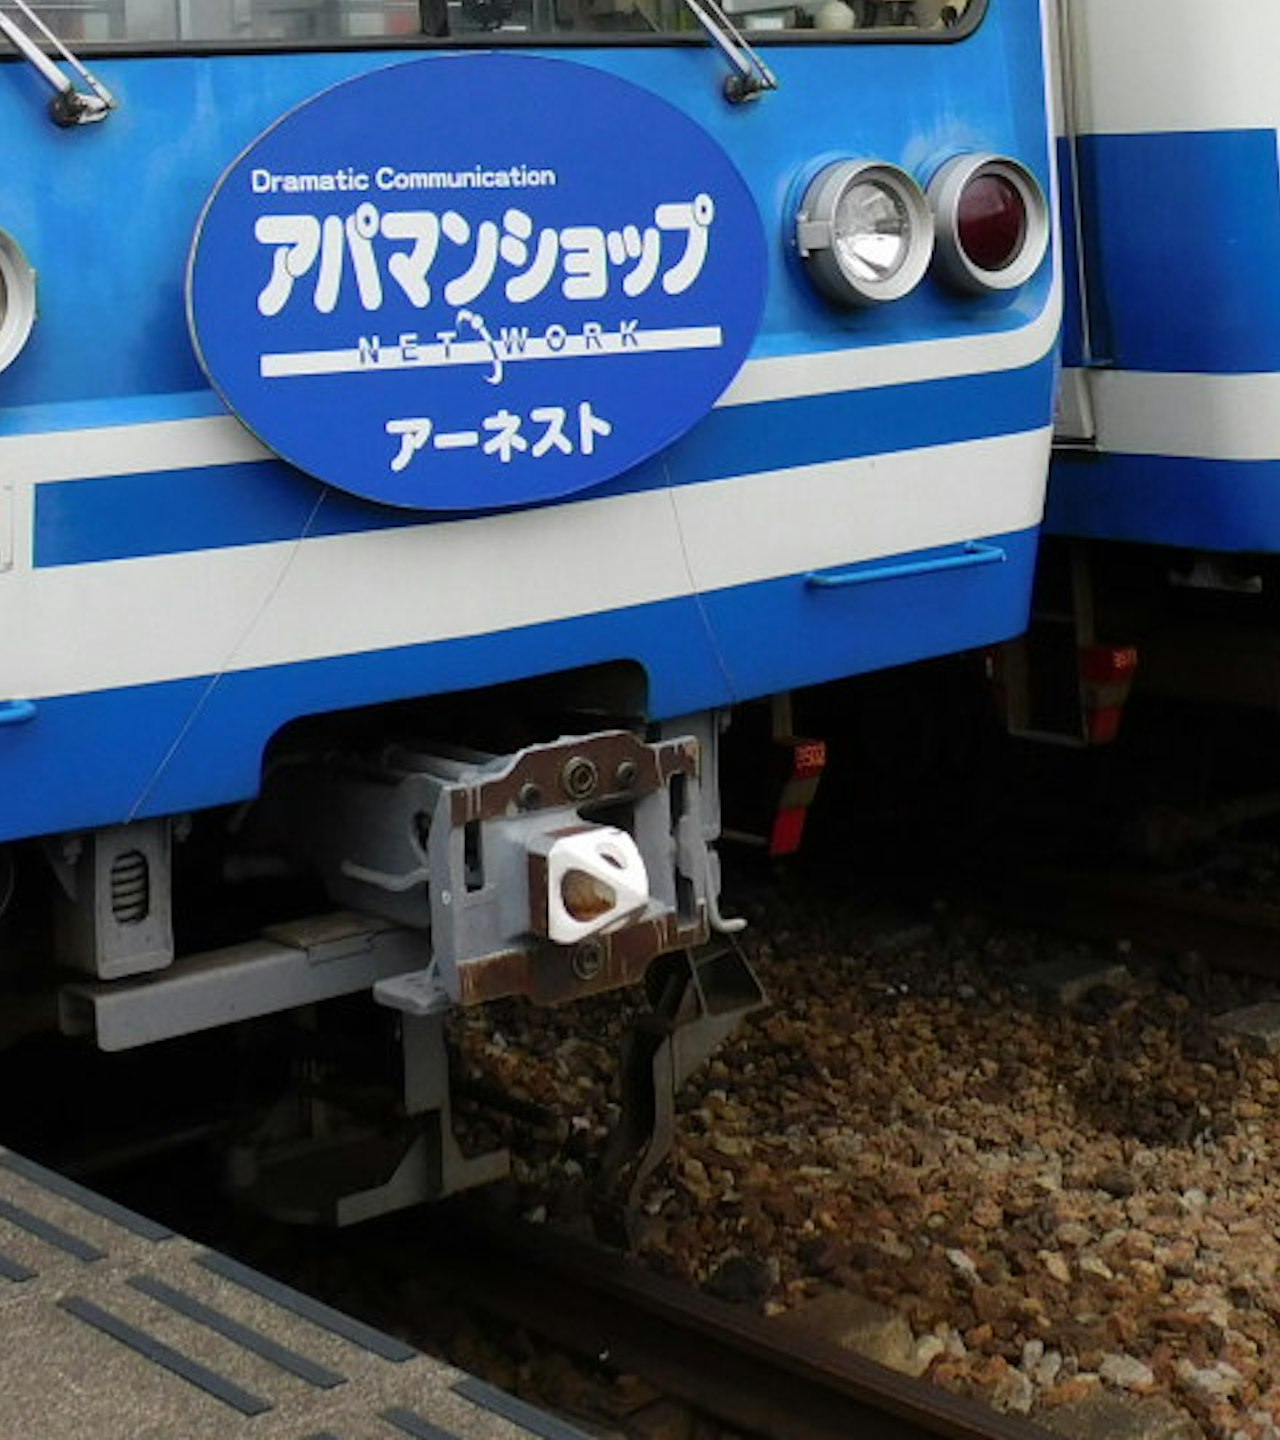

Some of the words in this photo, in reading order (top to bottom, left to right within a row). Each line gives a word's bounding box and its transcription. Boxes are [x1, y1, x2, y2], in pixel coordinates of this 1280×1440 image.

[251, 168, 370, 194] Dramatic
[375, 165, 557, 191] Communication
[254, 192, 714, 316] アパマンショップ
[386, 401, 613, 473] アーネスト
